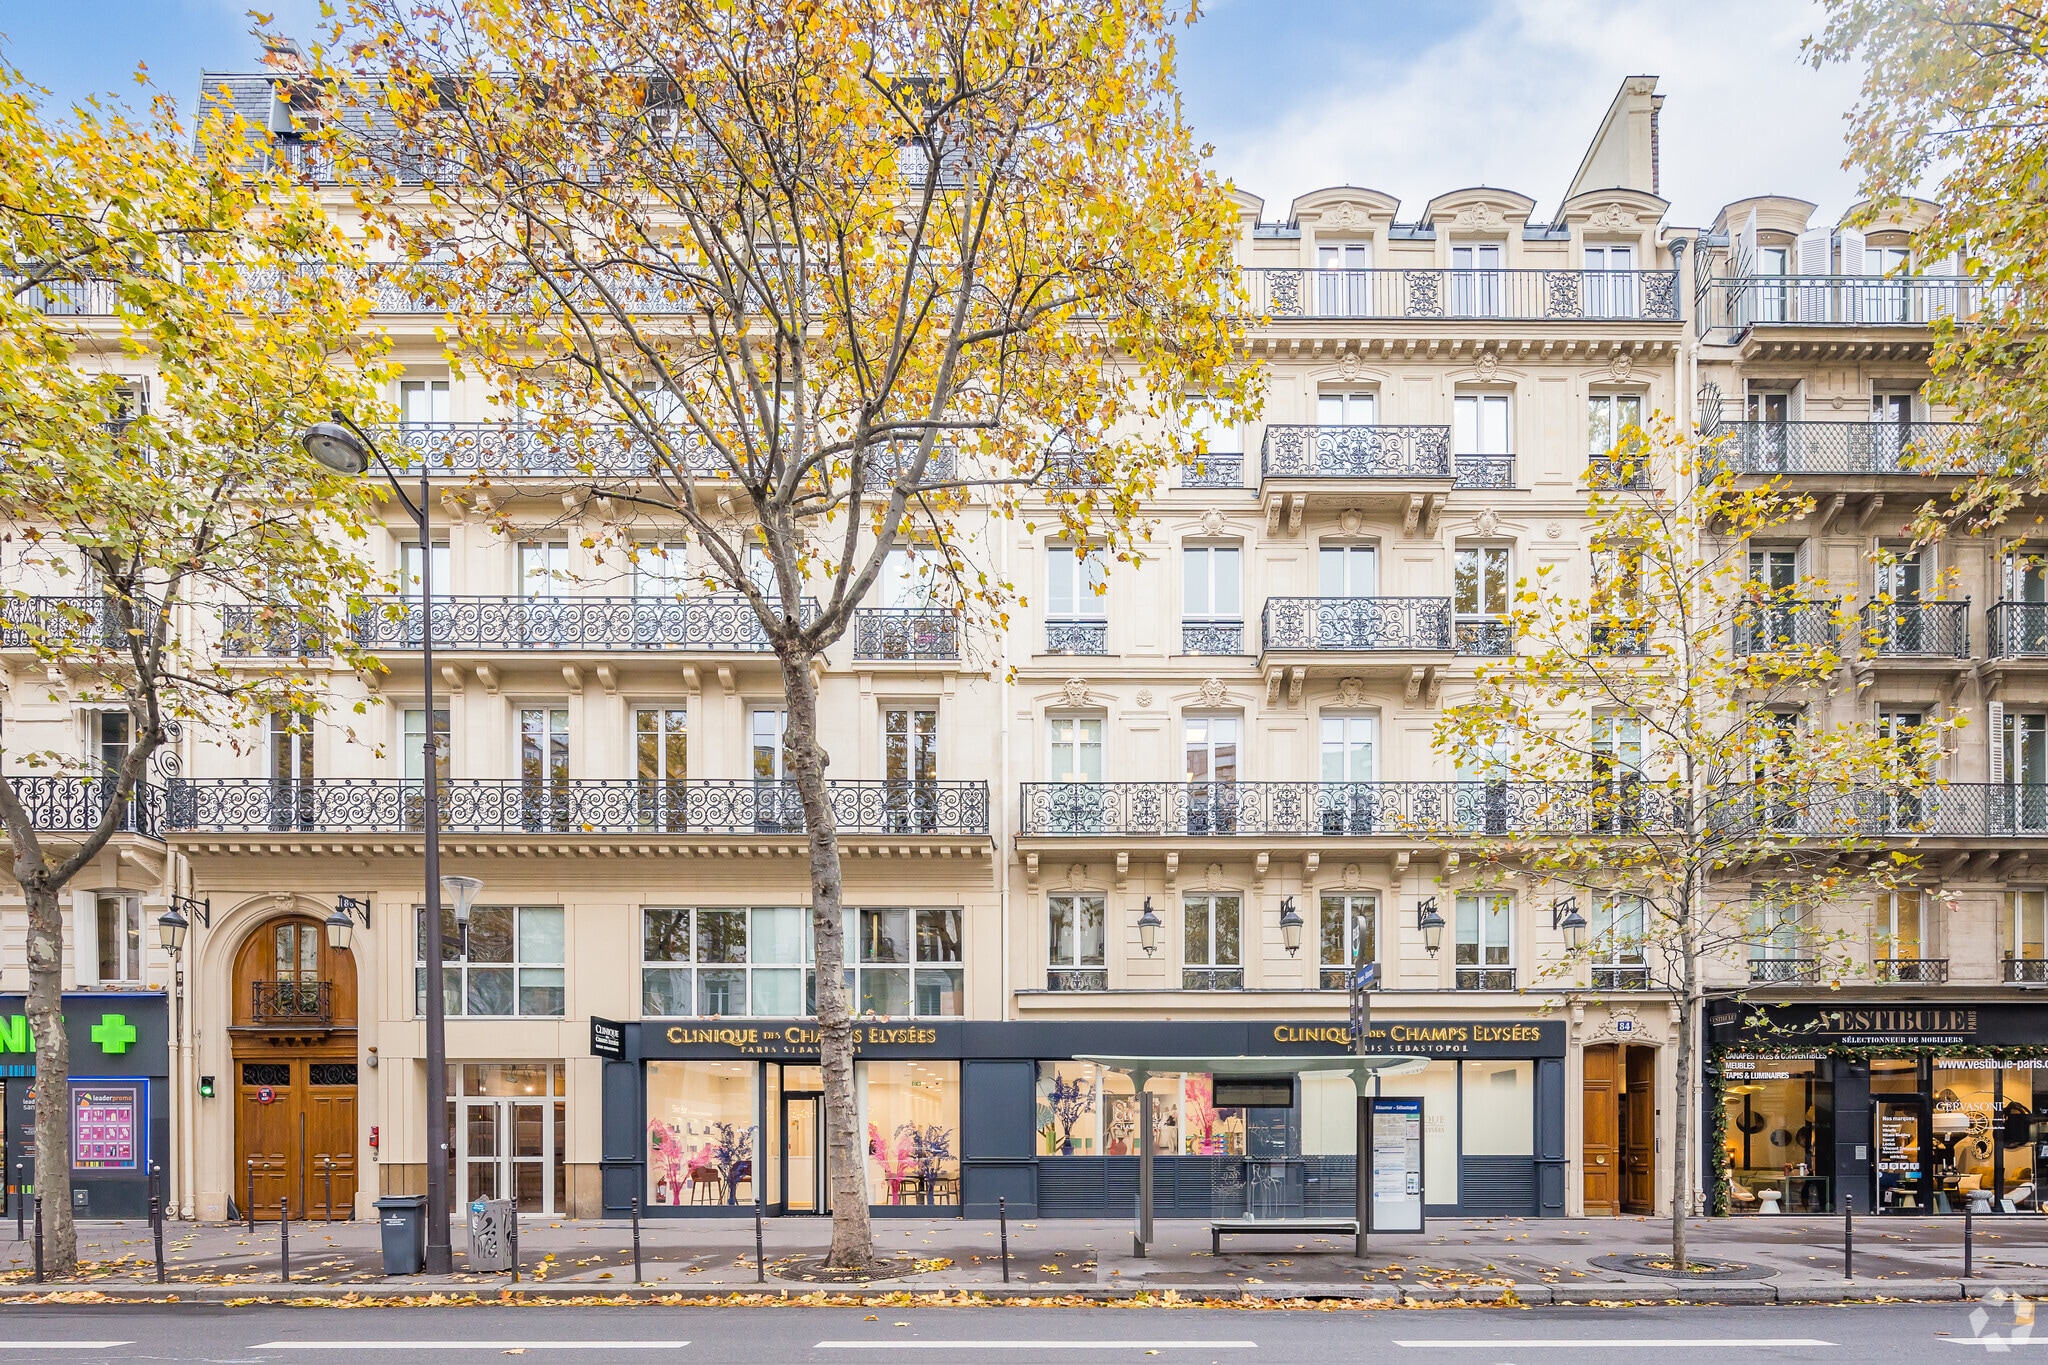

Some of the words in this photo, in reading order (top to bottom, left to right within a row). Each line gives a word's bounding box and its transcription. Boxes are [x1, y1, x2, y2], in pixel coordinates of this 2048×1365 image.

[1819, 1010, 1966, 1031] VESTIBULE
[1968, 1010, 1977, 1030] PARIS
[1619, 1022, 1631, 1031] 84
[667, 1026, 758, 1047] CLINIQUE
[868, 1026, 936, 1044] ELYSÉES
[1273, 1025, 1352, 1046] CLINIQU
[1368, 1030, 1387, 1038] DES
[1390, 1025, 1468, 1042] CHAMPS
[1473, 1024, 1541, 1042] ELYSÉES
[1841, 1036, 1906, 1044] SÉLECTIONNEUR
[1725, 1071, 1744, 1079] TAPIS
[93, 1094, 133, 1103] leaderpromo
[1935, 1101, 2005, 1112] GERVASONI
